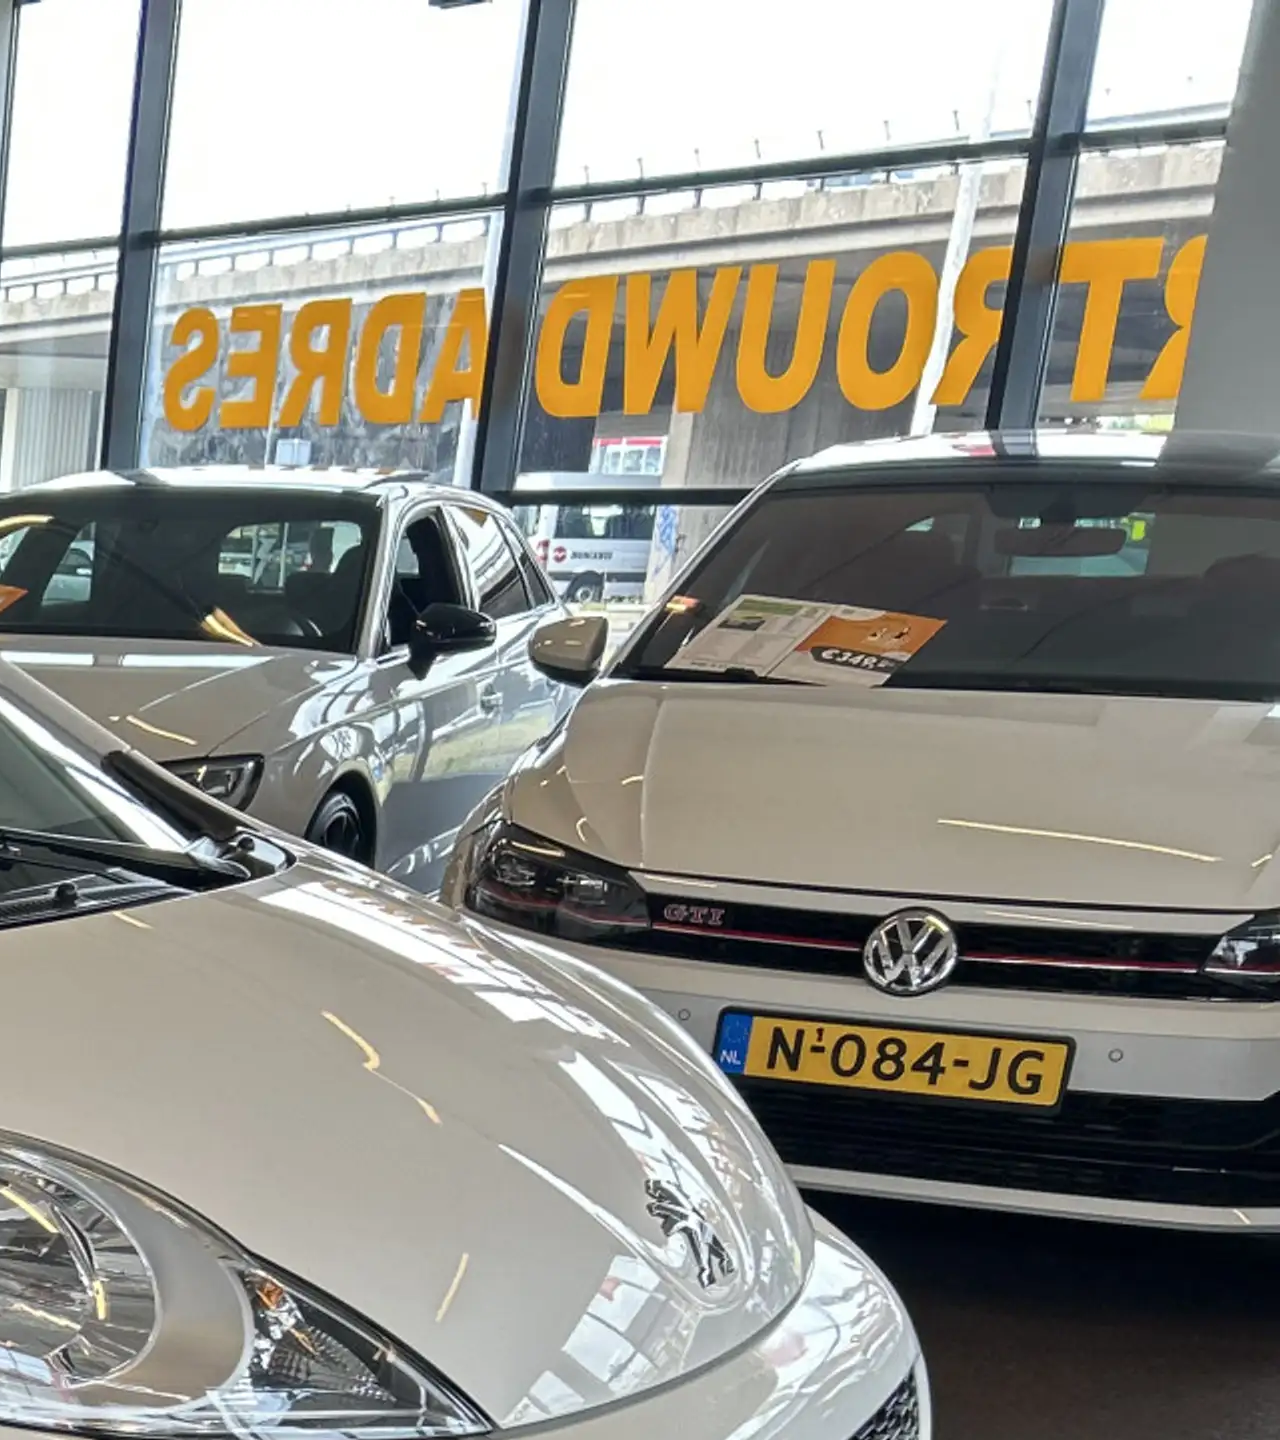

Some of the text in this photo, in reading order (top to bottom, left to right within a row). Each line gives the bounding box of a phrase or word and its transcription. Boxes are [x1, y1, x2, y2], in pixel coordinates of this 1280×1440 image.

[663, 903, 725, 926] GTI
[719, 1048, 742, 1067] NL
[766, 1025, 1046, 1097] N-084-JG
